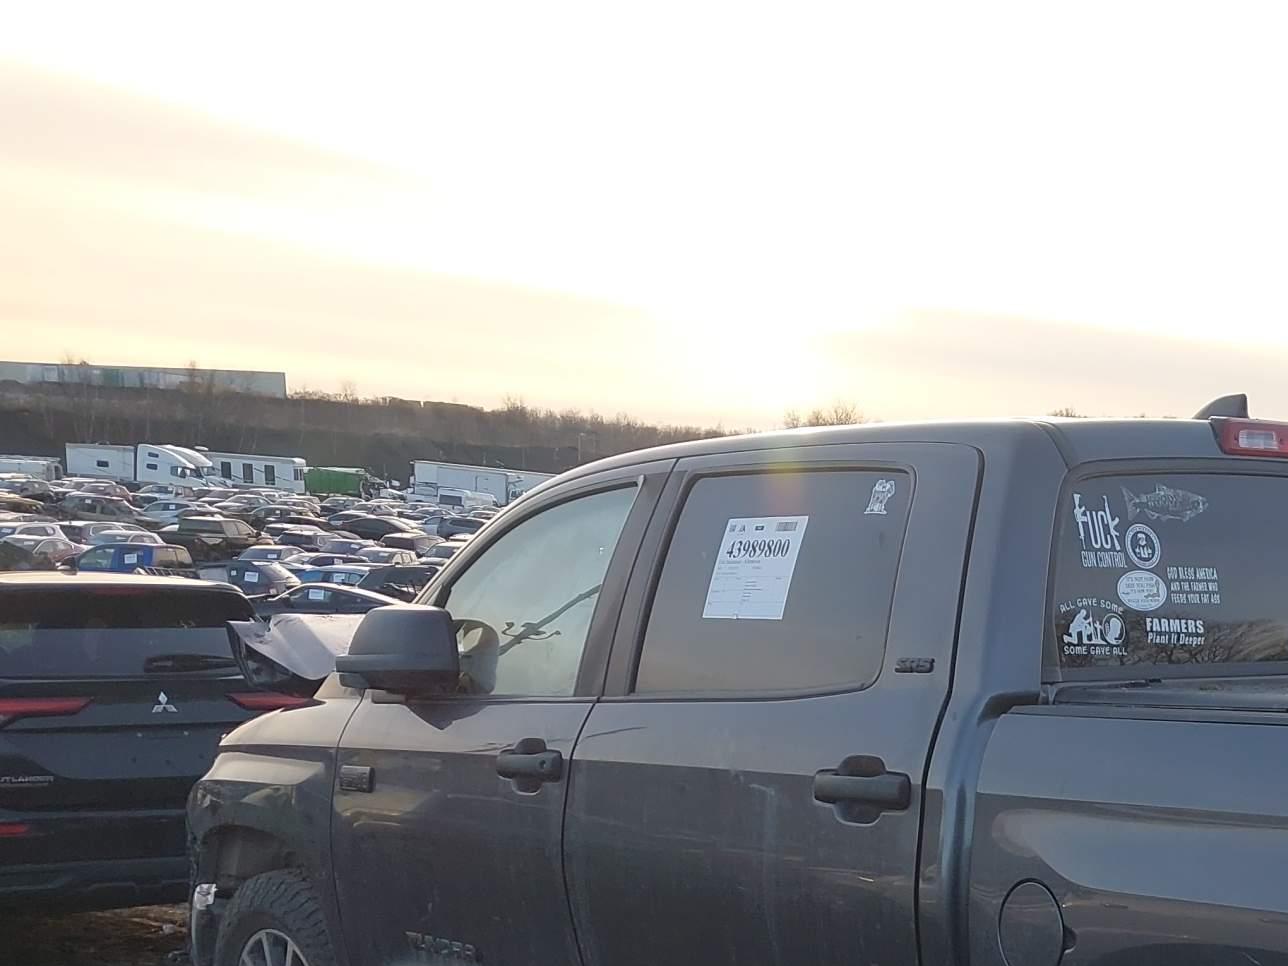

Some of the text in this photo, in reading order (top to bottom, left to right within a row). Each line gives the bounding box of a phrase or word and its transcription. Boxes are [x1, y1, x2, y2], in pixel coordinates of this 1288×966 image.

[726, 538, 791, 558] 43989800
[1081, 551, 1128, 568] GUN CONTROL
[1060, 597, 1124, 615] ALL GAVE SOME
[1146, 617, 1204, 634] FARMERS
[1147, 632, 1169, 644] Plant
[1063, 645, 1128, 656] SOME GAVE ALL
